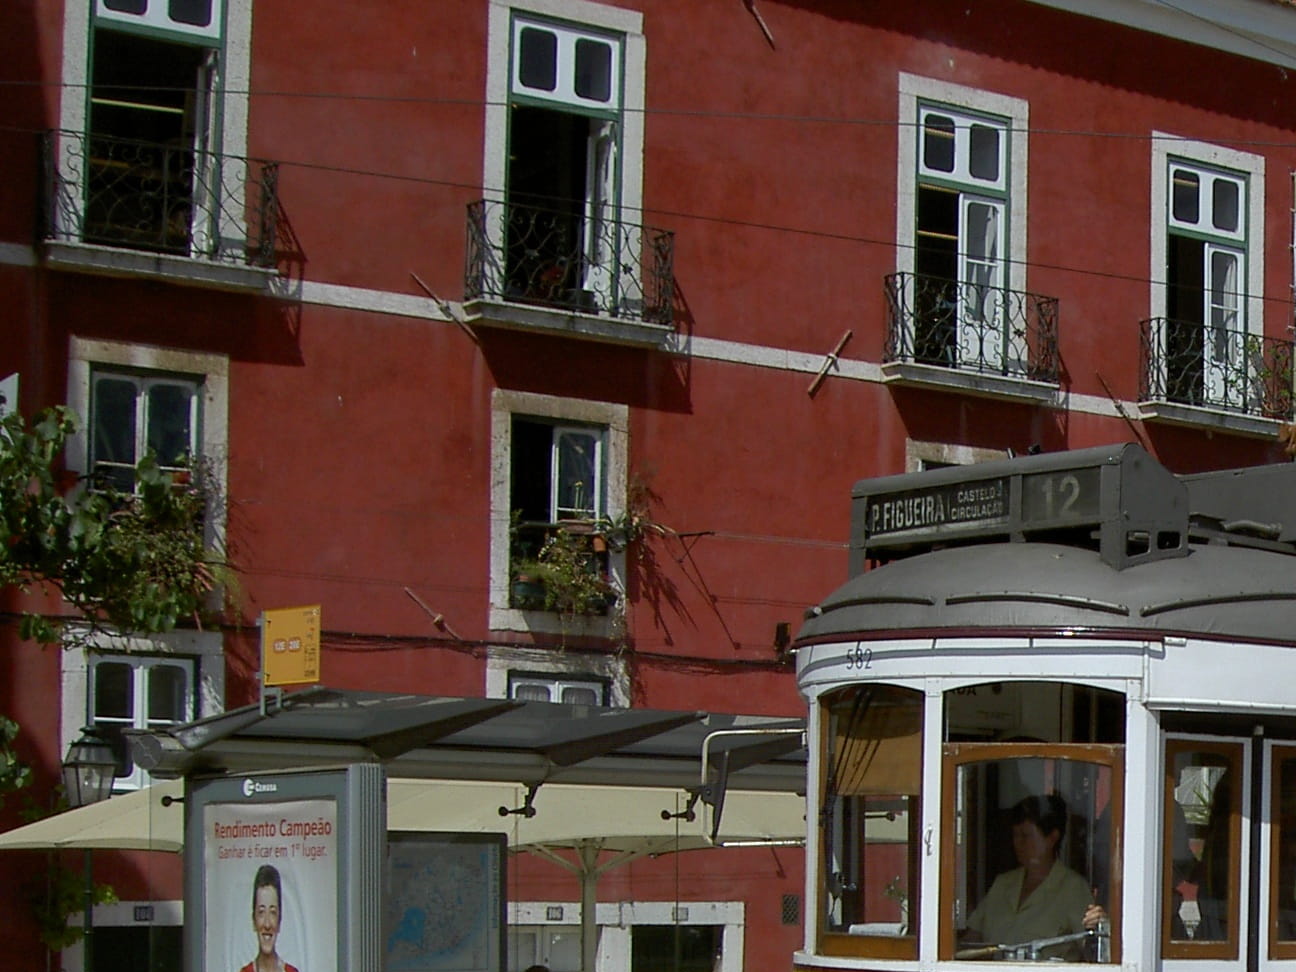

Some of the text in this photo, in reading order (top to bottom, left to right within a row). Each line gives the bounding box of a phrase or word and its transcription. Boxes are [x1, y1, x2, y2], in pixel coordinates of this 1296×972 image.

[1041, 475, 1080, 520] 12
[882, 494, 945, 531] FIGUEIRA
[846, 648, 873, 670] 582
[214, 817, 332, 840] Rendimento Campeão
[218, 845, 246, 859] Ganhar
[254, 844, 273, 858] ficar
[275, 846, 288, 858] em
